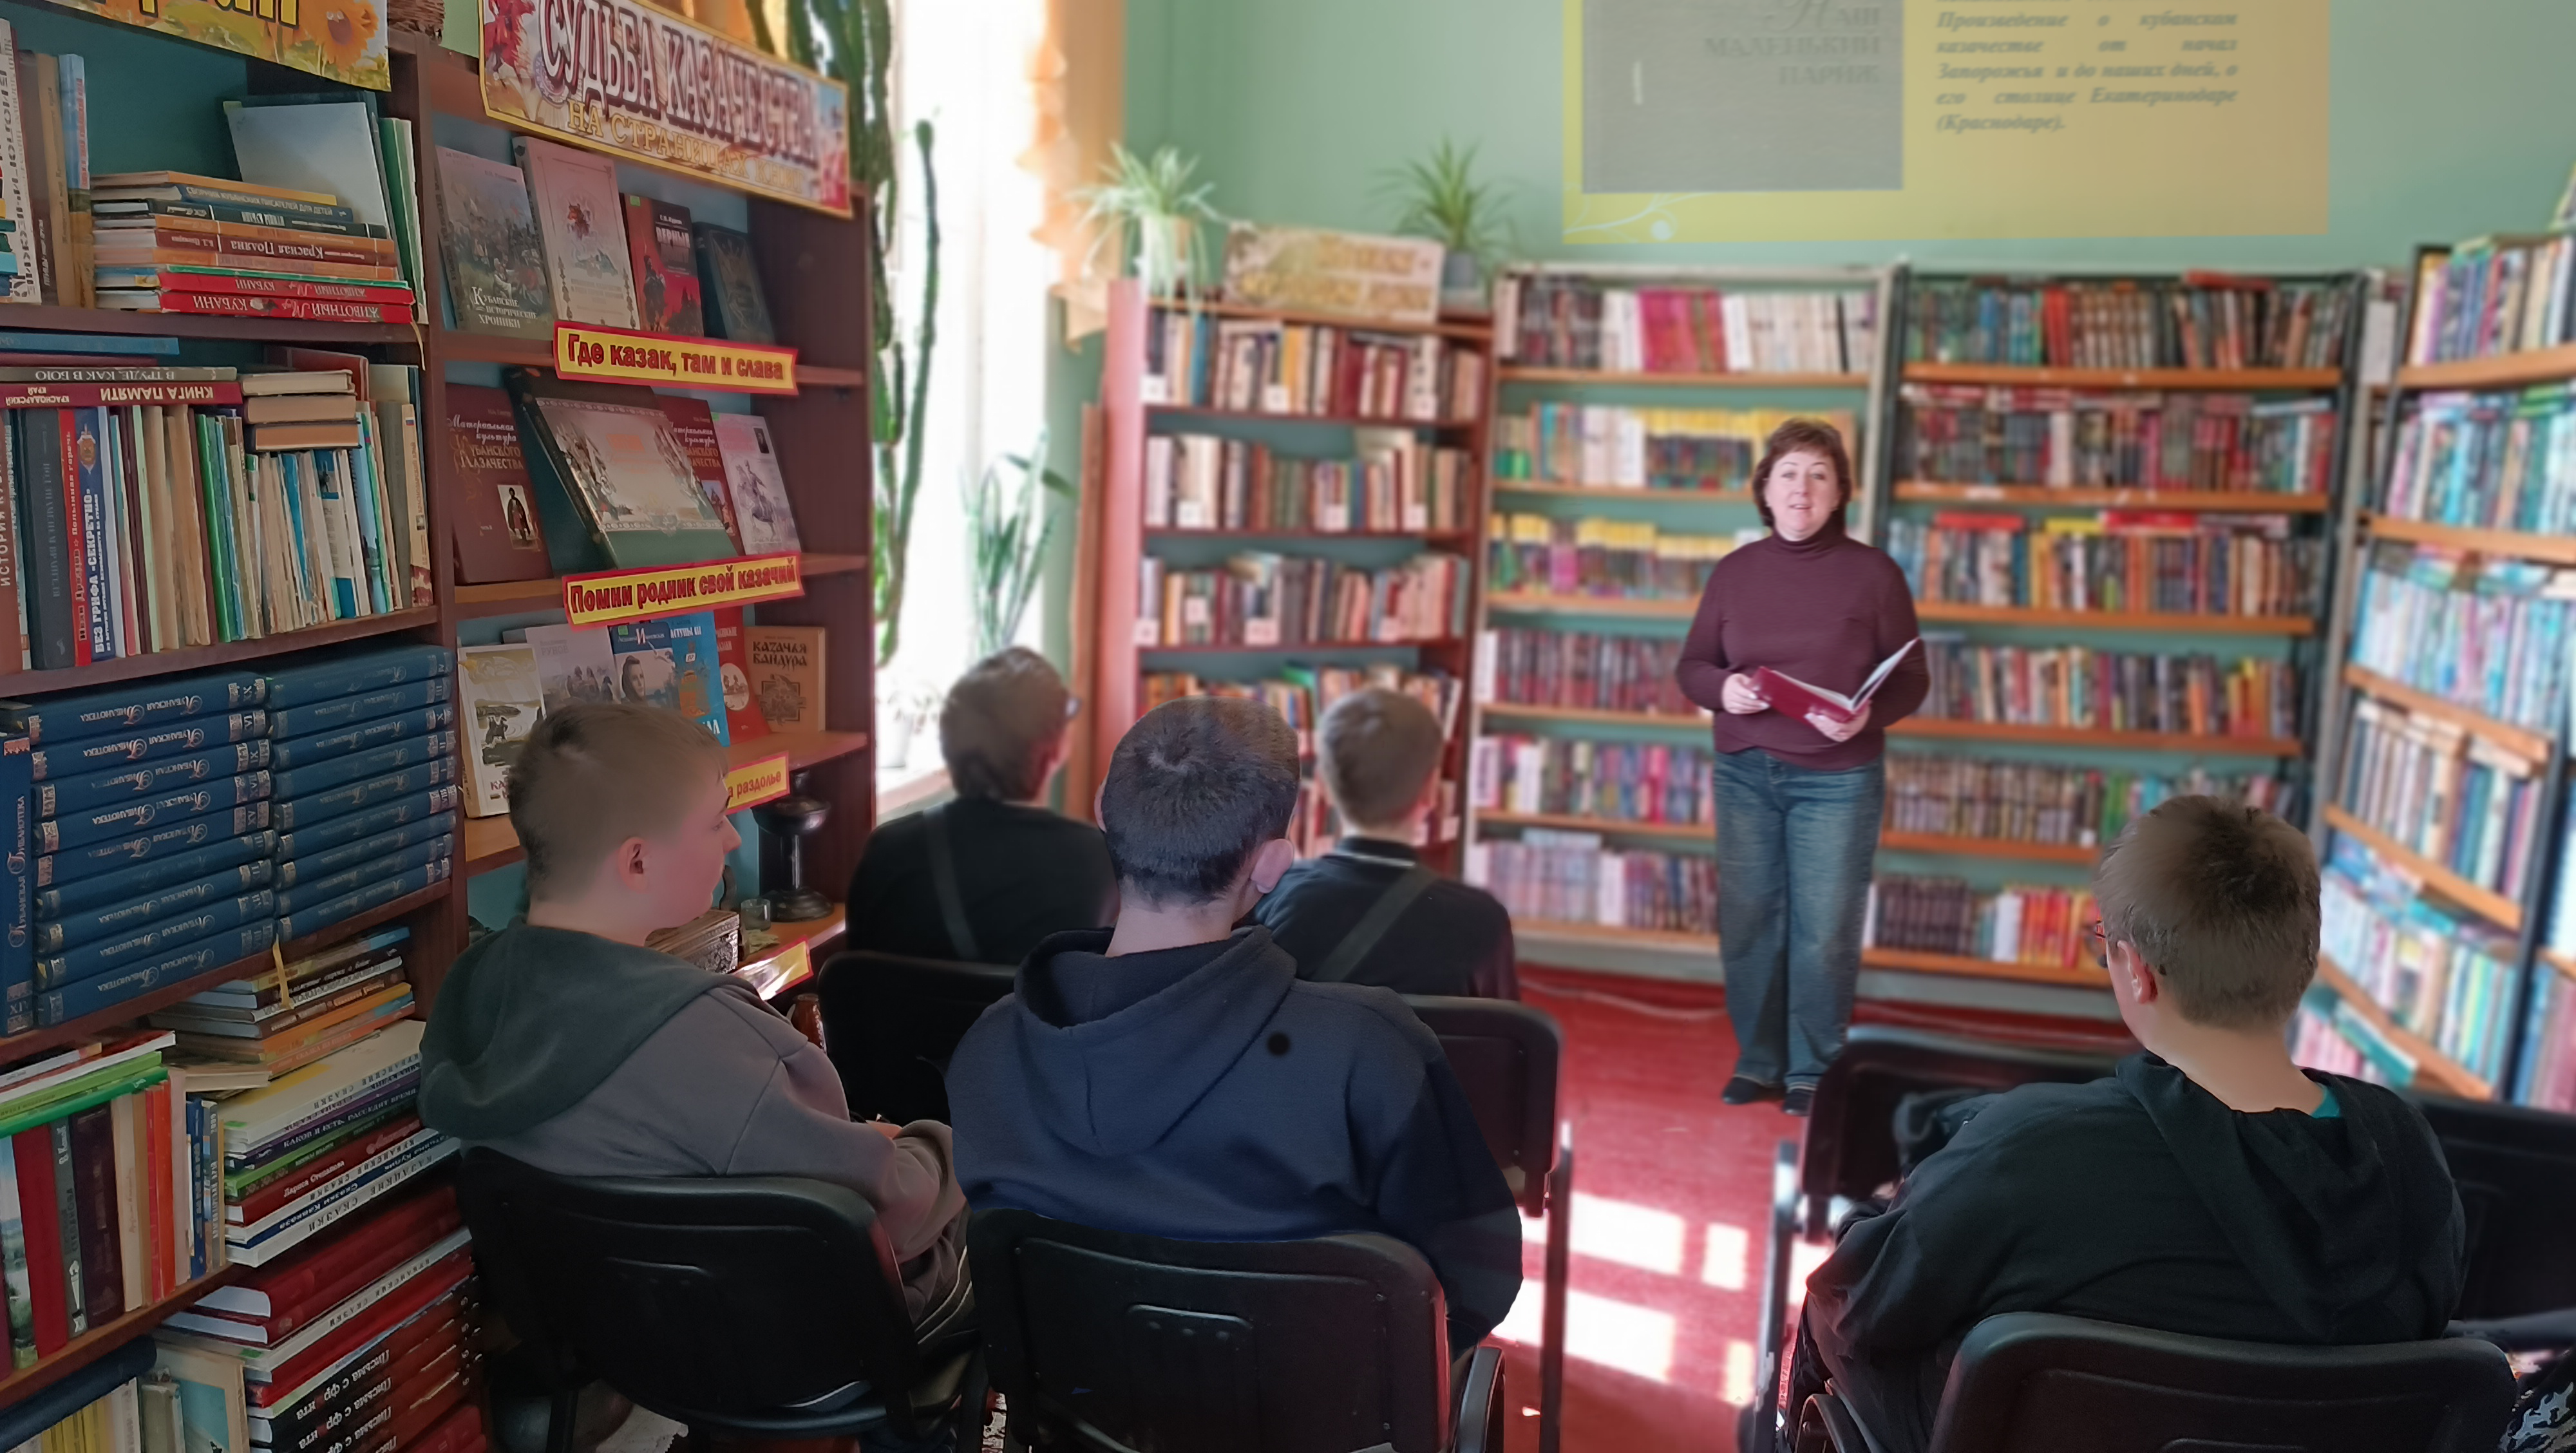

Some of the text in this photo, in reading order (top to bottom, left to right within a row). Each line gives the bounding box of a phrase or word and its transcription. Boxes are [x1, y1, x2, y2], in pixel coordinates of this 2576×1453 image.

[568, 98, 604, 138] НА
[610, 113, 750, 178] СТРАНИЦАХ
[193, 295, 248, 310] КУБАНИ
[312, 303, 380, 318] ЖИВОТНЫЙ
[568, 334, 784, 381] Где казак, там и слава
[100, 386, 214, 401] КНИГА ПАМЯТИ
[571, 557, 797, 614] Помни родник свой казачий
[737, 771, 782, 799] раздолье
